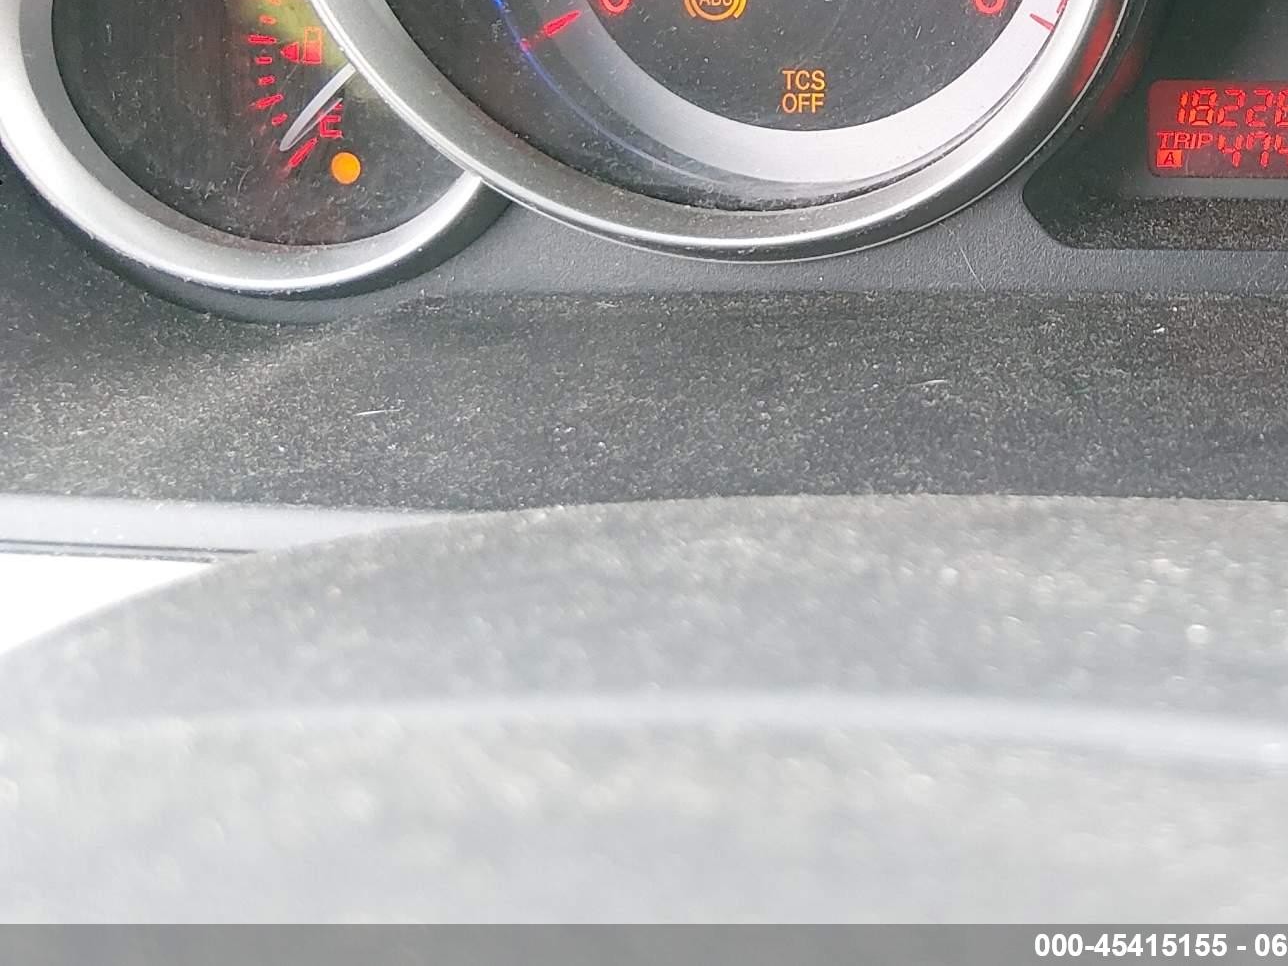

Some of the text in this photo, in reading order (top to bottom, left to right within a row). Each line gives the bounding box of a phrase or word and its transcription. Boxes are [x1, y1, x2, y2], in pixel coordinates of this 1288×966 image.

[781, 69, 826, 91] TCS
[781, 92, 825, 114] OFF
[1156, 131, 1214, 149] TRIP
